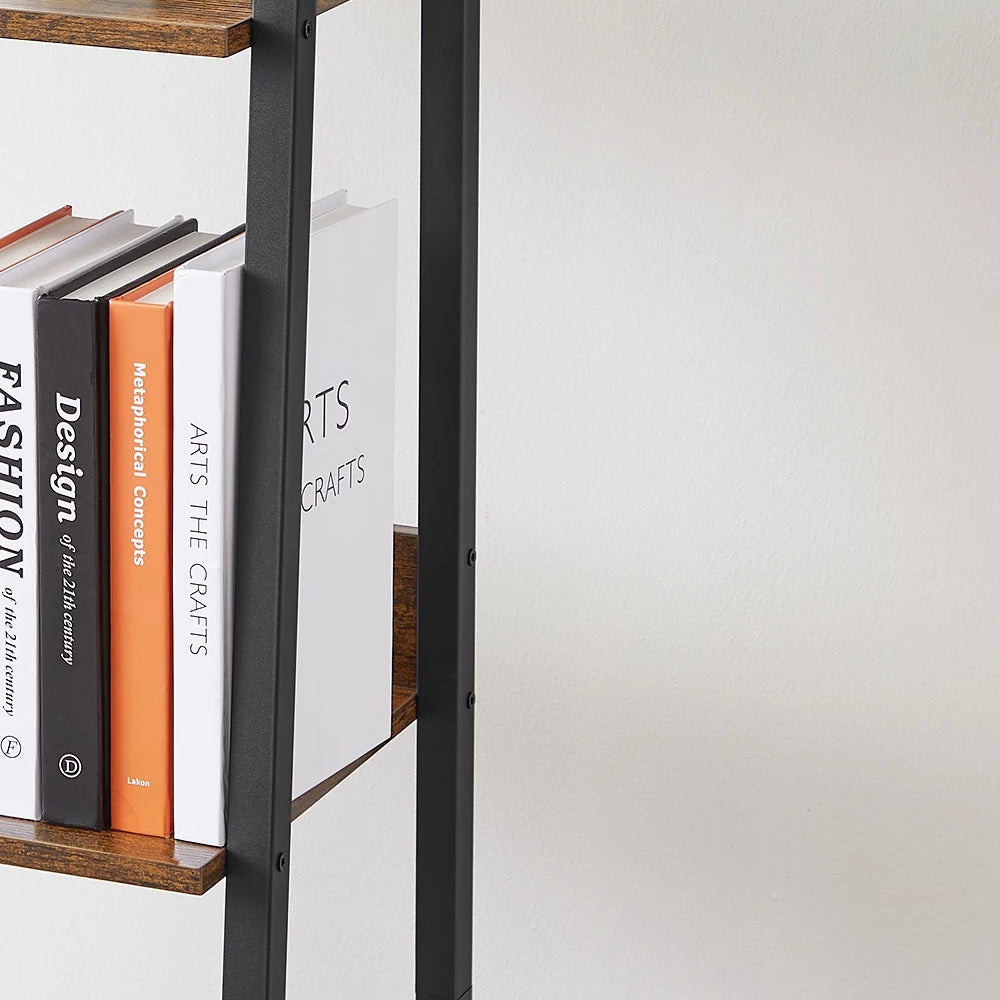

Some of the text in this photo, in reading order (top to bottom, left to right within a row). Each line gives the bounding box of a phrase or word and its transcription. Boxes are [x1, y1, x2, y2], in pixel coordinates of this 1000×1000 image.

[130, 362, 148, 567] Metaphorical Concepts
[300, 454, 366, 512] CRAFTS
[50, 392, 84, 666] Design of the 21th century
[189, 422, 209, 657] ARTS THE CRAFTS
[1, 587, 17, 605] of
[4, 606, 17, 629] the
[4, 631, 17, 663] 21th
[2, 665, 14, 717] century
[126, 776, 151, 788] Lakon
